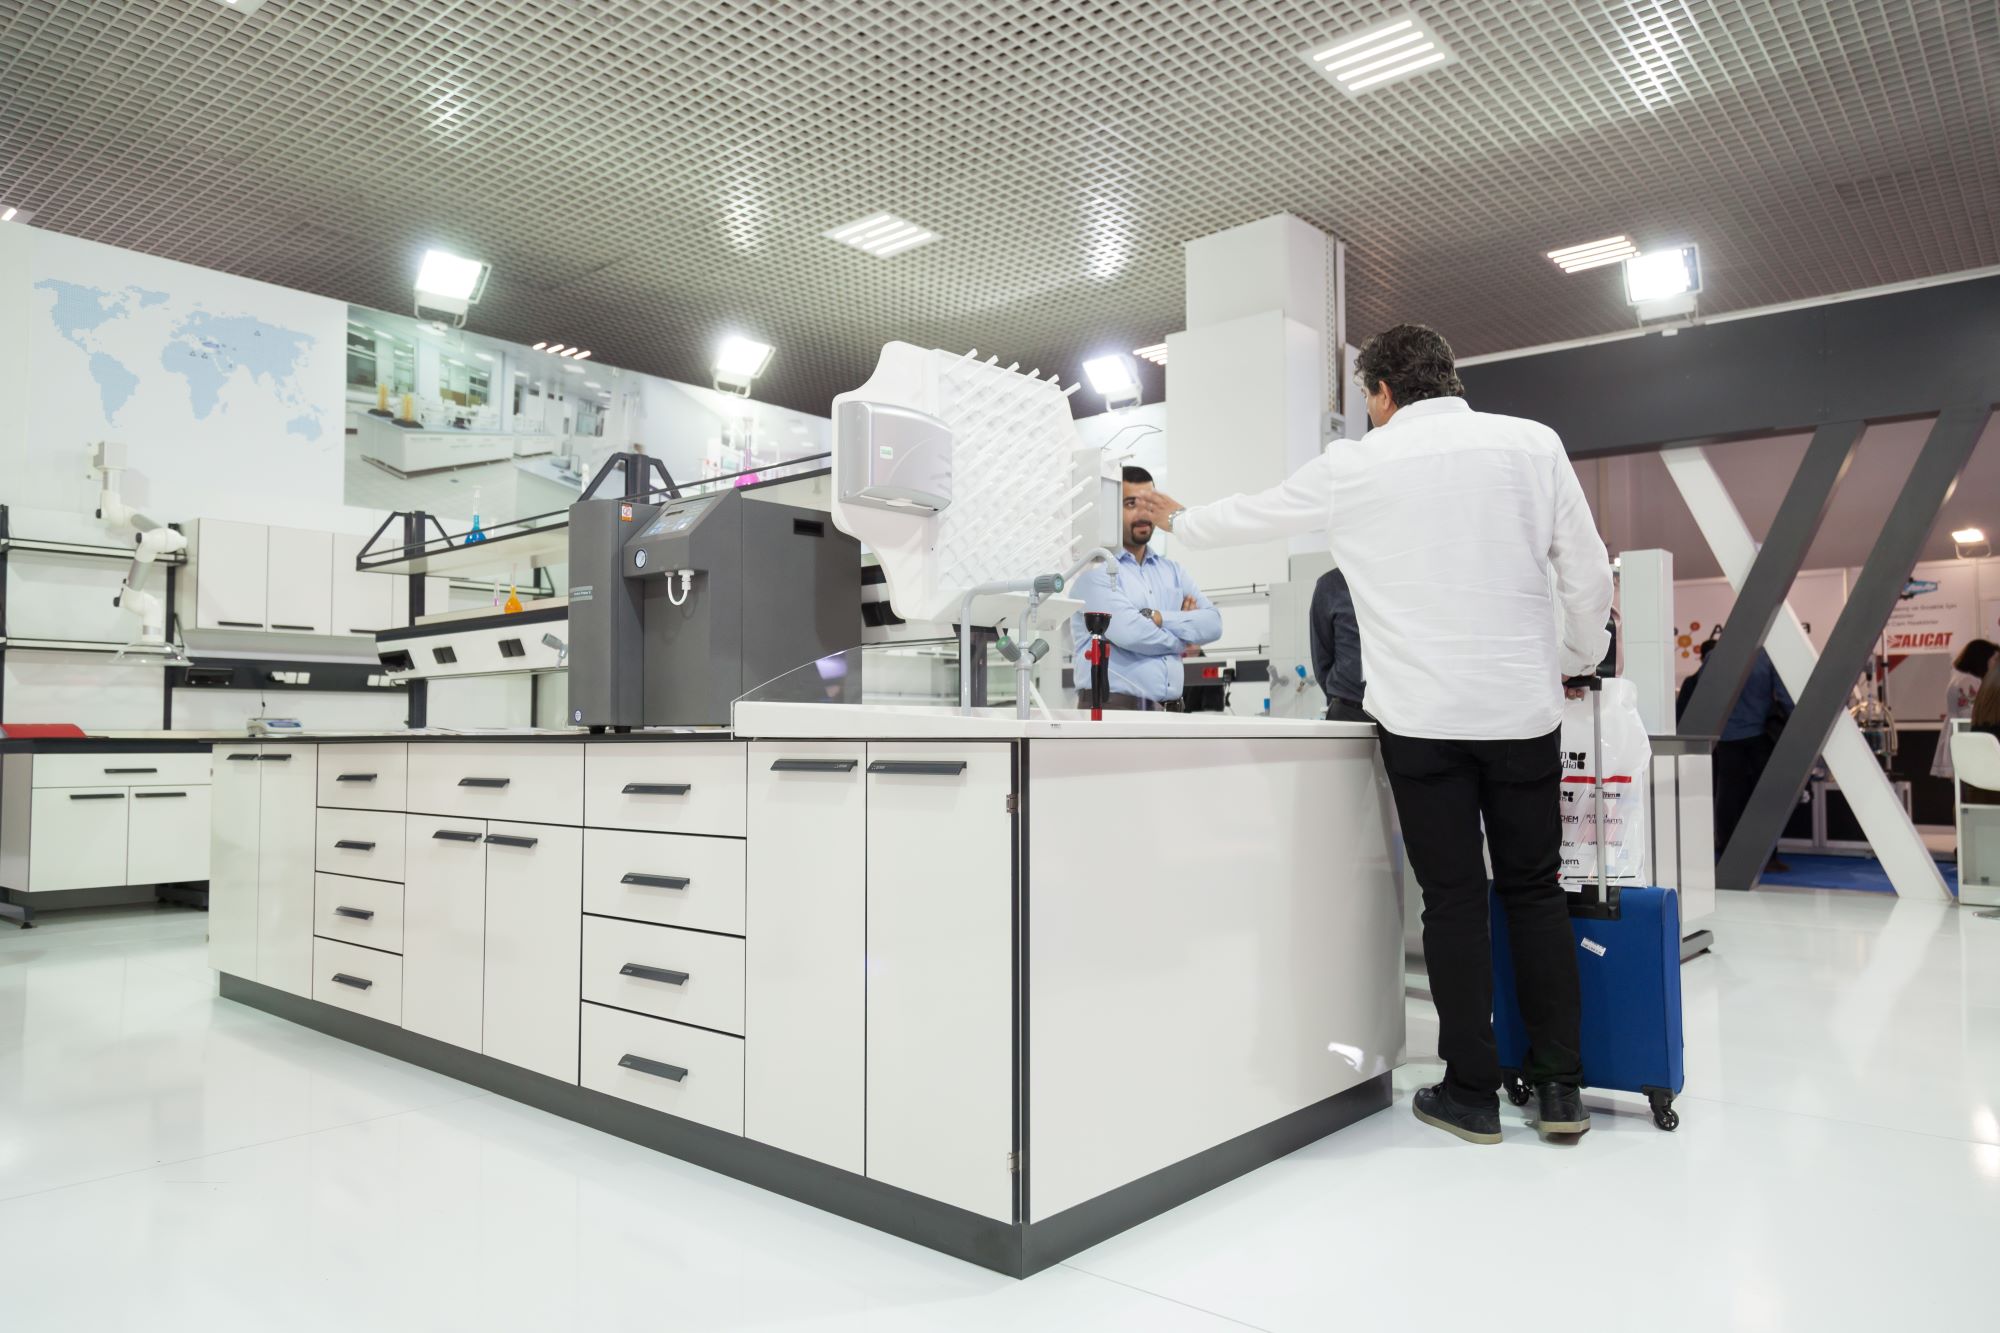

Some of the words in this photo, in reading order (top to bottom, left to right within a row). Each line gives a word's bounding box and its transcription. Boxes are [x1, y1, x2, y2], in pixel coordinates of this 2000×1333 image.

[1900, 631, 1954, 648] ALICAT
[1562, 759, 1577, 769] dia
[1560, 815, 1579, 823] CHEM
